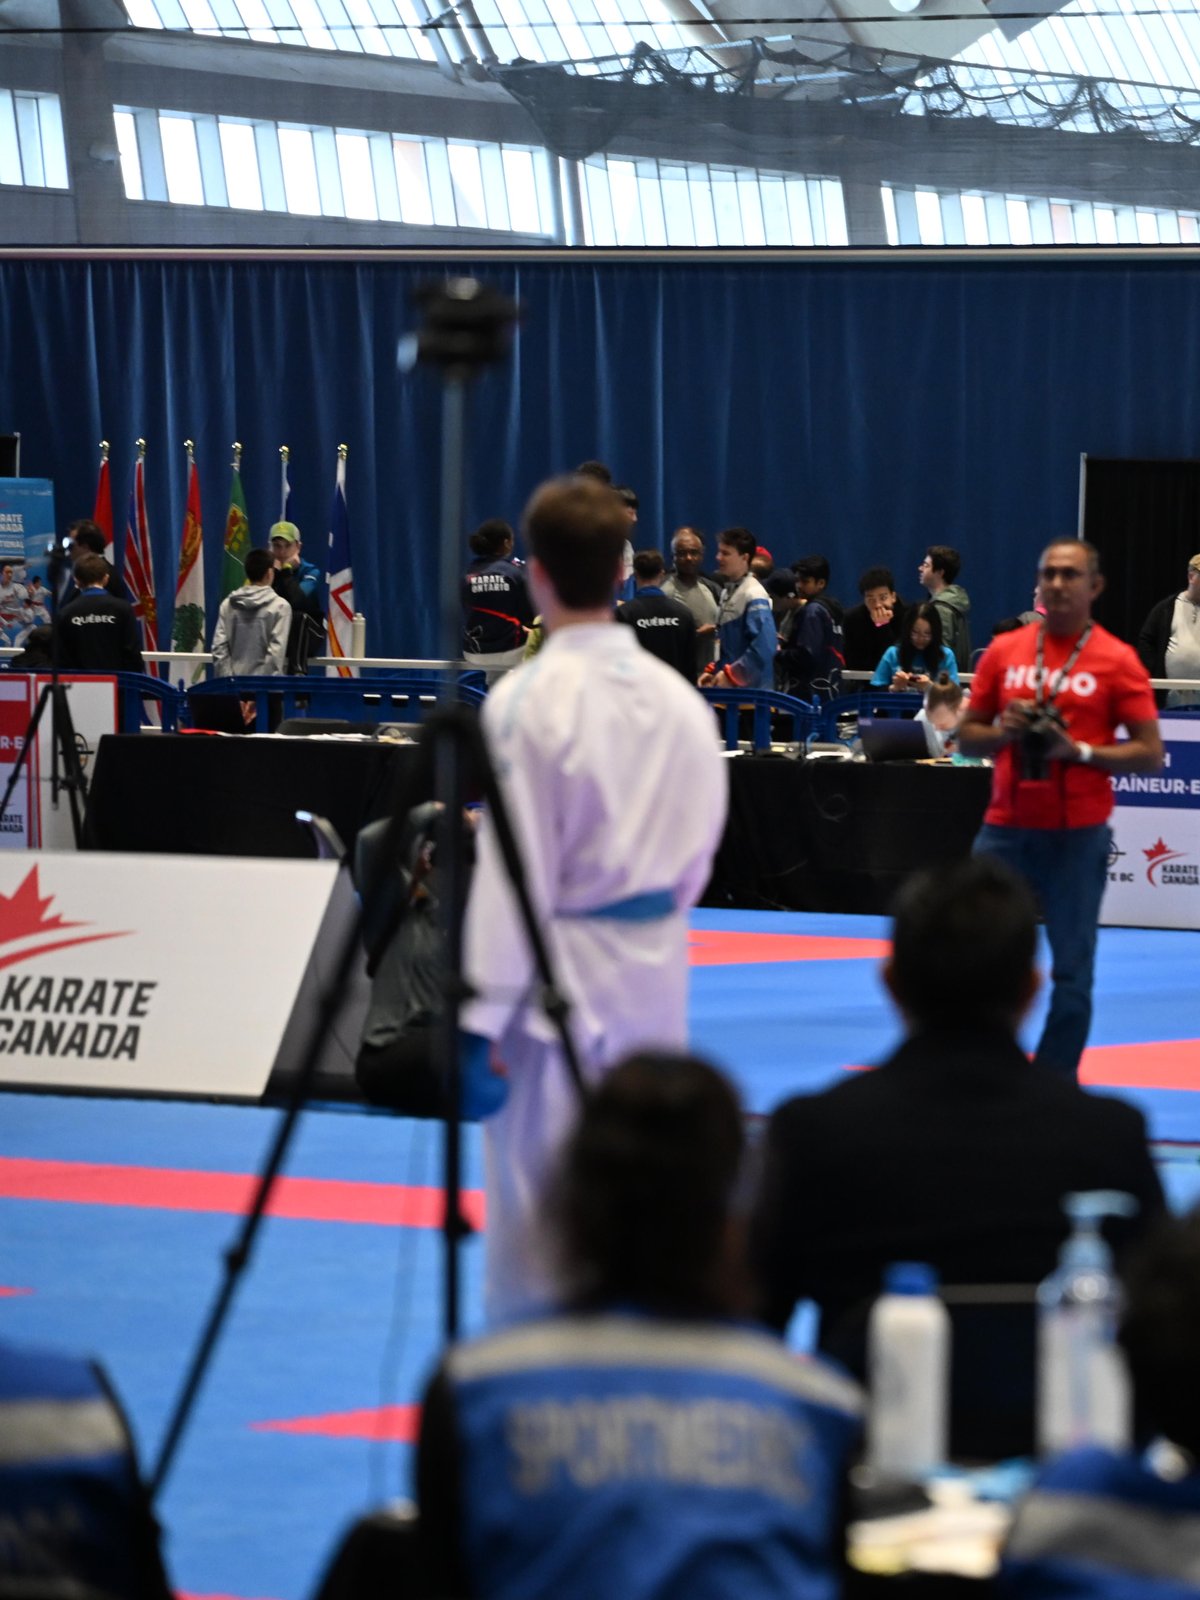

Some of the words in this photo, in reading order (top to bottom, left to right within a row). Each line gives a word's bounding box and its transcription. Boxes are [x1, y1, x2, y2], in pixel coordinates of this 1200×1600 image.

[471, 575, 505, 584] KARATE
[472, 583, 510, 593] ONTARIO
[72, 614, 116, 626] QUÉBEC
[637, 616, 679, 628] QUÉBEC
[1003, 664, 1098, 697] HUGO
[1162, 864, 1199, 875] KARATE
[1120, 873, 1134, 882] BC
[1161, 875, 1200, 885] CANADA
[0, 975, 158, 1017] KARATE
